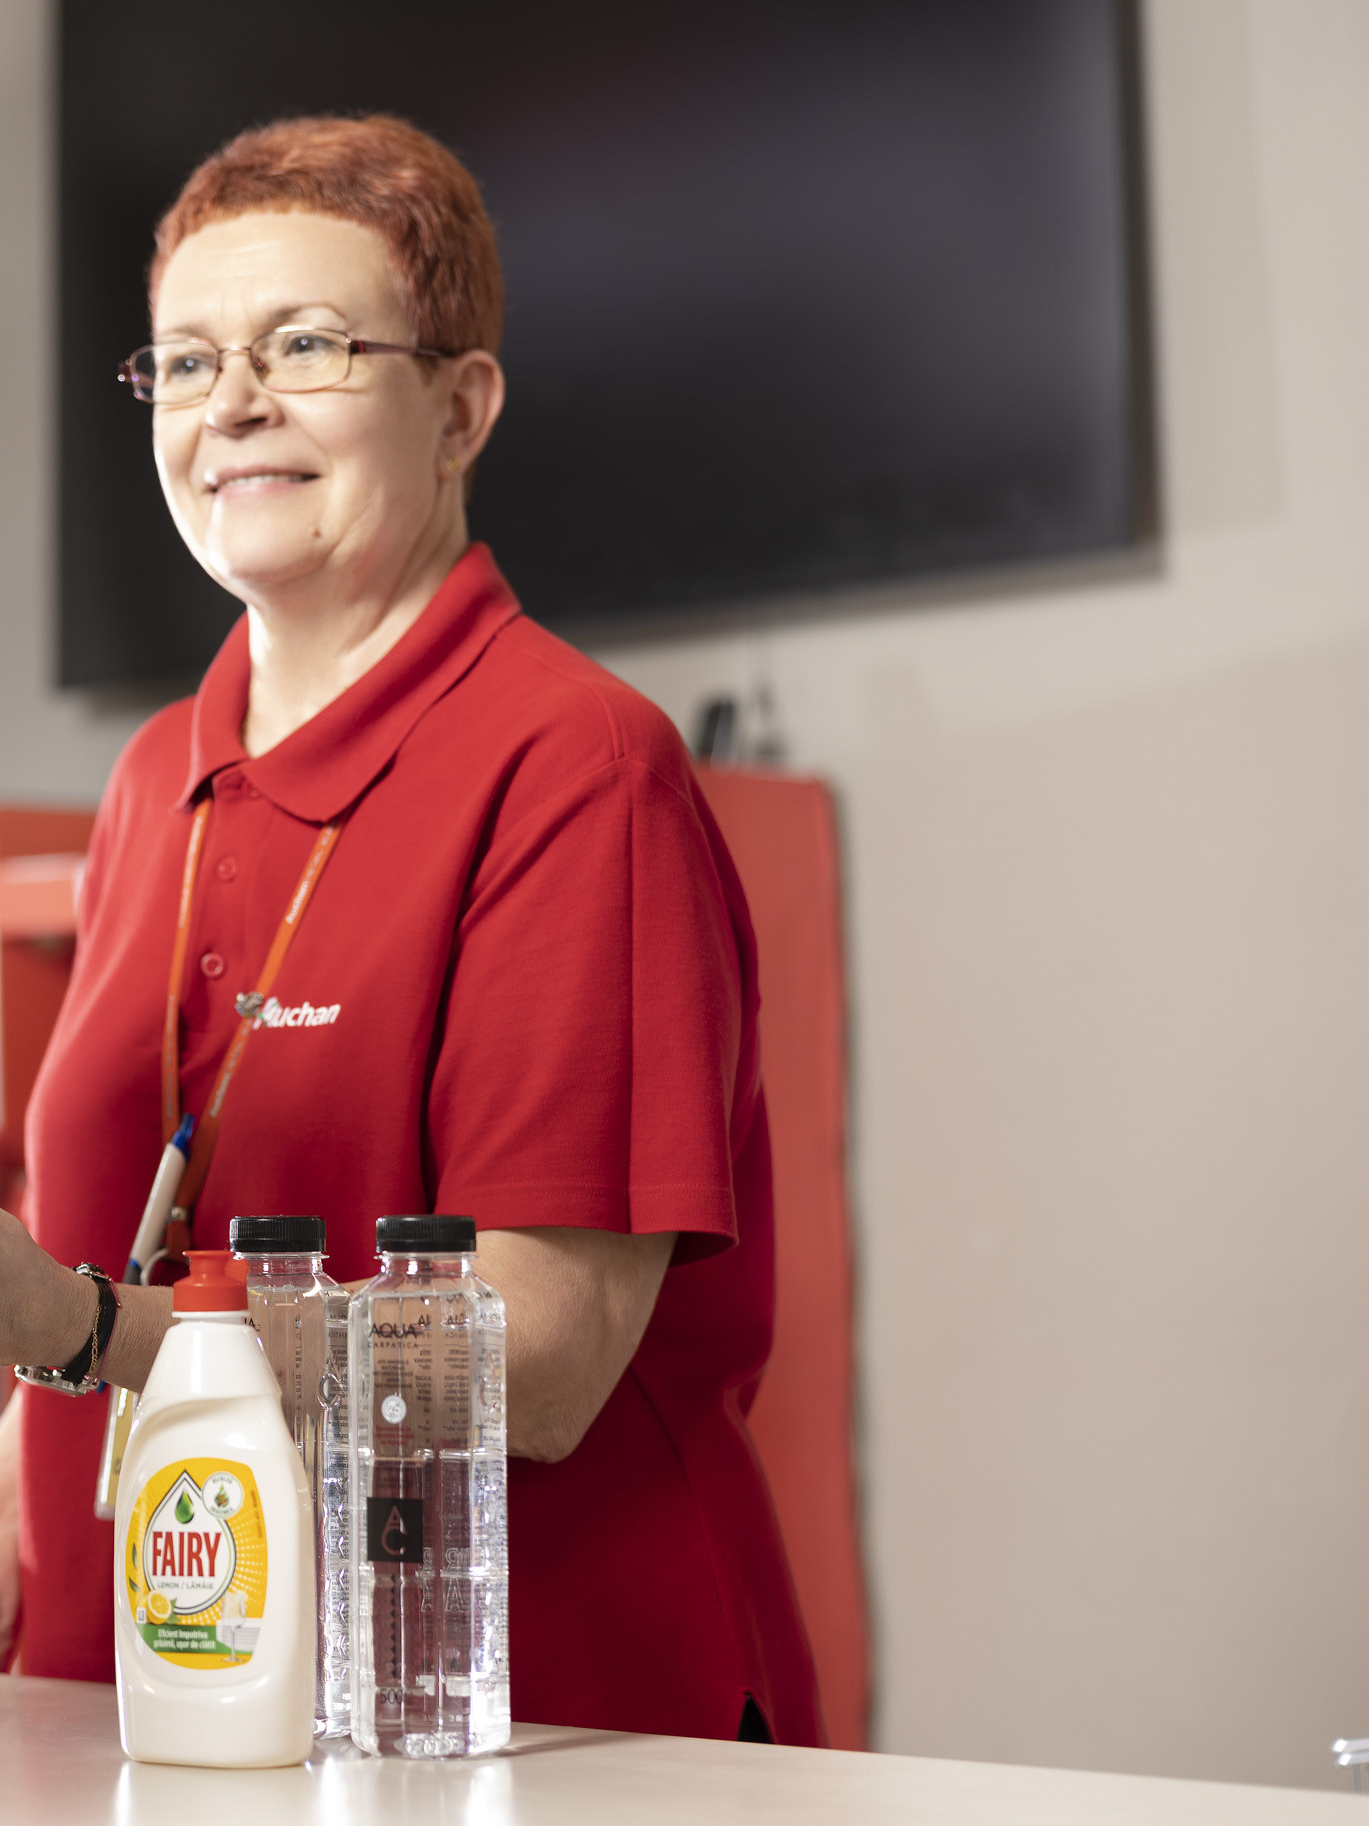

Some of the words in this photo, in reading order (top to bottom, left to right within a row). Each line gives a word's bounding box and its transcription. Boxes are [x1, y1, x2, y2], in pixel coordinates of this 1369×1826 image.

[252, 996, 341, 1030] Auchan
[369, 1323, 417, 1339] AQUA
[152, 1531, 222, 1577] FAIRY
[157, 1581, 179, 1589] LEMON
